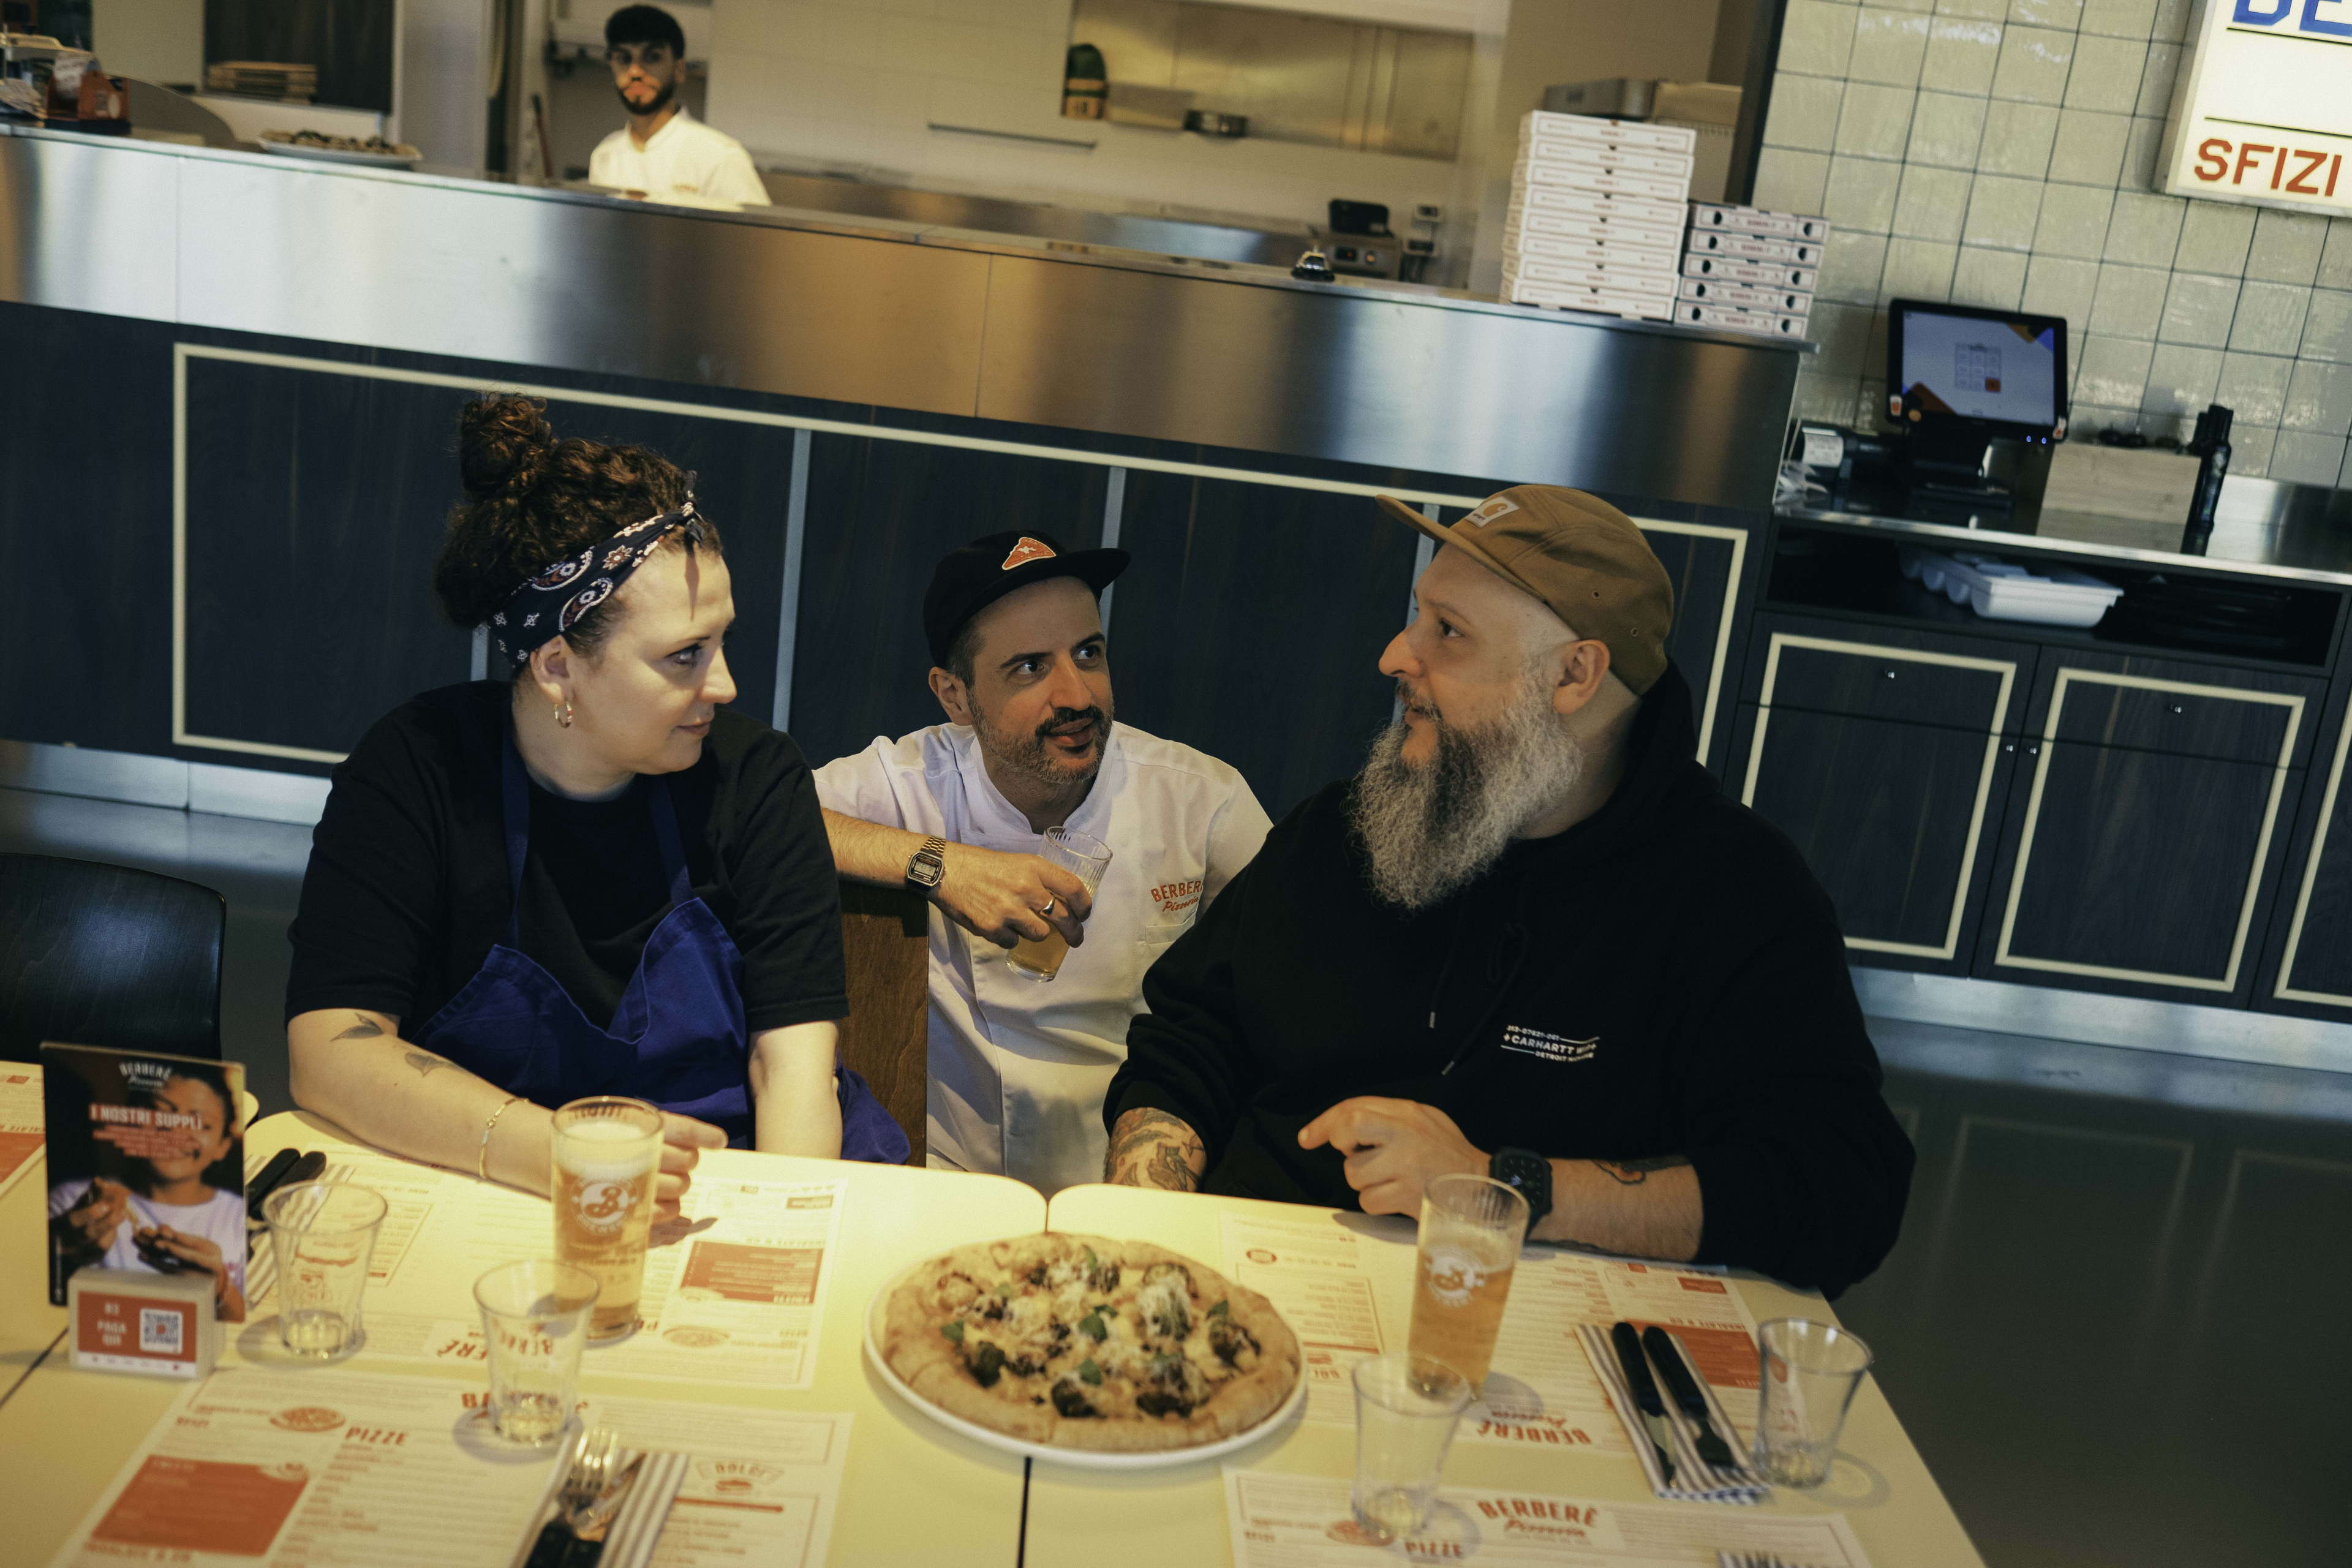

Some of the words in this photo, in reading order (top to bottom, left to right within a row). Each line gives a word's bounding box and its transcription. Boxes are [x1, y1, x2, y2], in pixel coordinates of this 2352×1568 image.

[2195, 138, 2342, 197] SFIZI
[1150, 880, 1204, 903] BERBER
[1162, 896, 1199, 912] Pizzeria
[100, 1106, 151, 1125] NOSTRI
[345, 1427, 409, 1446] PIZZE
